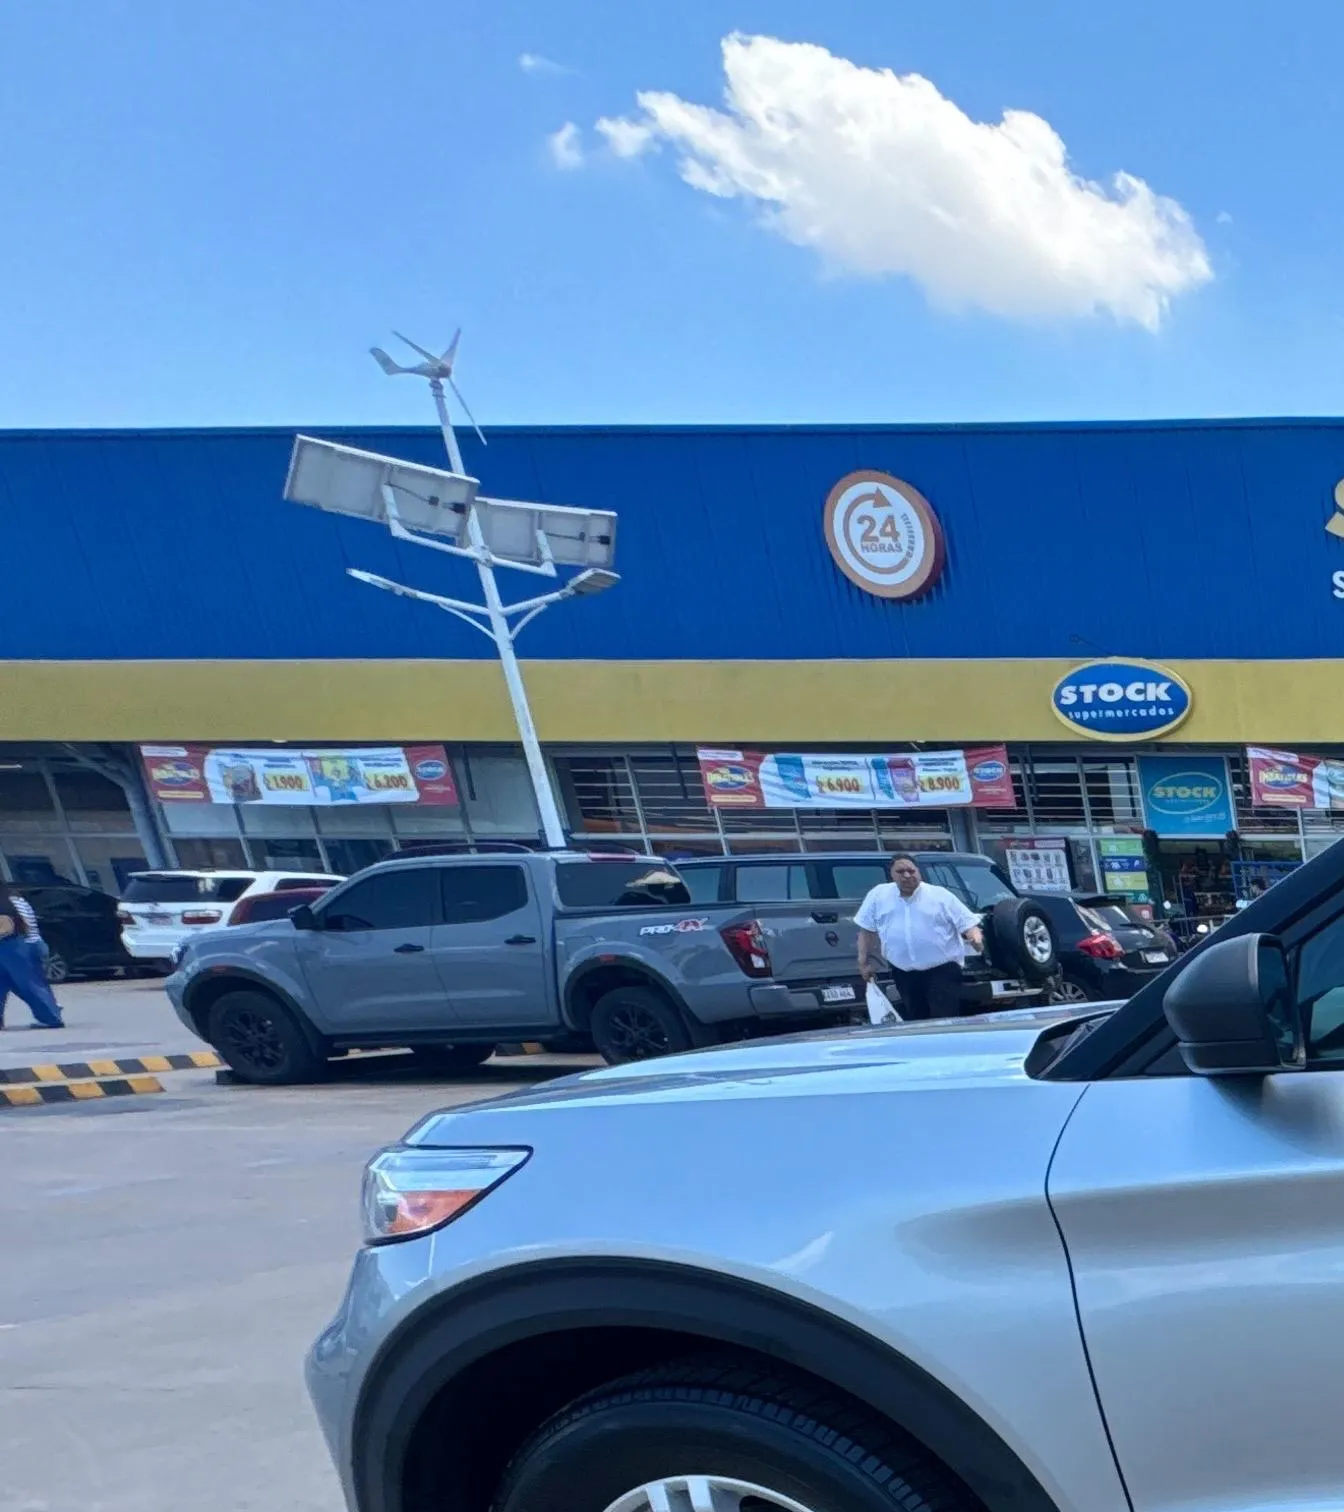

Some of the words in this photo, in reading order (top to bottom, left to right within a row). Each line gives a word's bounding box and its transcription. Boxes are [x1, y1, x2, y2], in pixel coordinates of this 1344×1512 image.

[857, 515, 901, 542] 24
[861, 542, 903, 553] HORAS
[1060, 682, 1172, 705] STOCK
[1068, 706, 1174, 720] supermercados
[1152, 786, 1216, 798] STOCK
